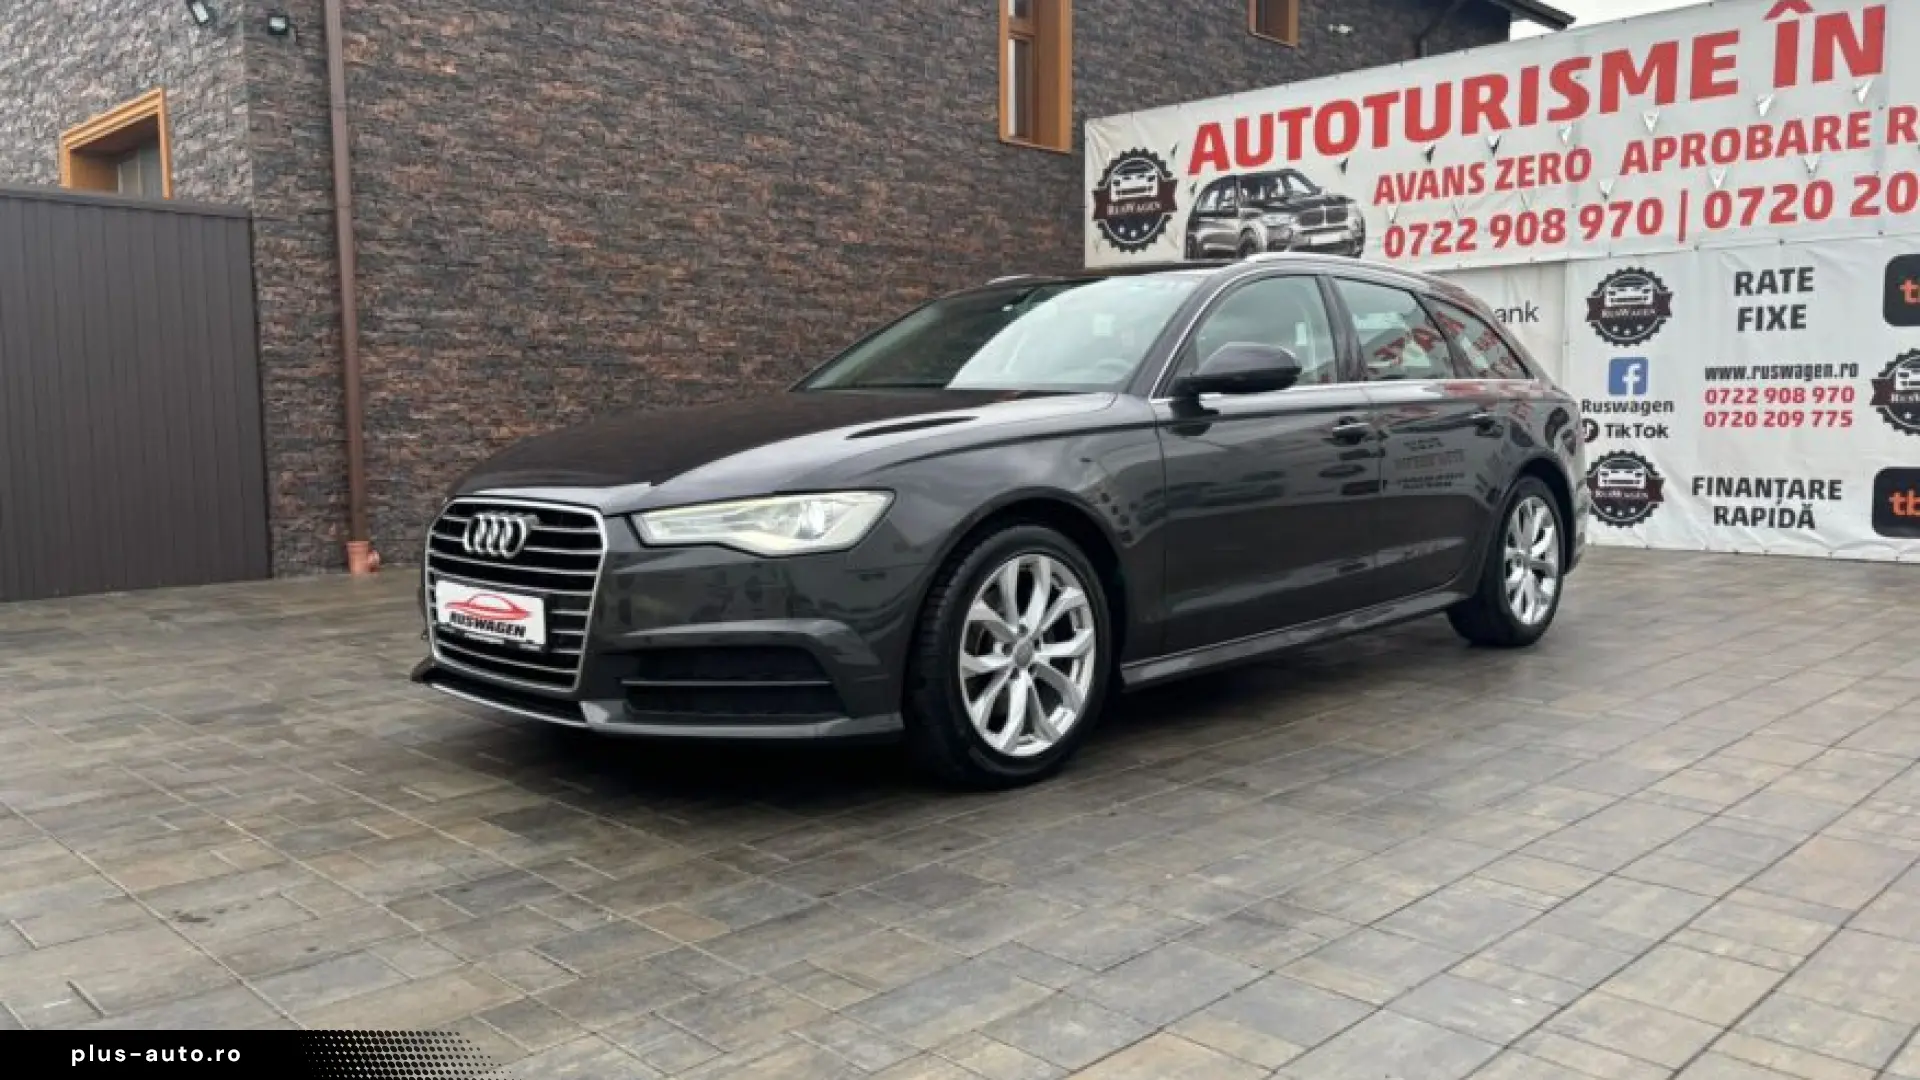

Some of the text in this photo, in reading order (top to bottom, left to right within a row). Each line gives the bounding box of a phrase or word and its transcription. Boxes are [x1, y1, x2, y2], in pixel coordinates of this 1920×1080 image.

[1187, 0, 1887, 176] AUTOTURISME ÎN
[1373, 162, 1487, 207] AVANS
[1493, 147, 1594, 192] ZERO
[1618, 110, 1873, 176] APROBARE
[1383, 217, 1479, 259] 0722
[1489, 207, 1567, 249] 908
[1578, 198, 1665, 241] 970
[1702, 178, 1835, 229] 0720
[1849, 170, 1920, 219] 20
[1734, 266, 1815, 297] RATE
[1494, 300, 1541, 323] ank
[1737, 304, 1807, 332] FIXE
[1704, 363, 1860, 382] www.ruswagen.ro
[1581, 399, 1675, 416] Ruswagen
[1704, 386, 1855, 405] 0722 908 970
[1604, 423, 1669, 439] TikTok
[1704, 410, 1853, 428] 0720 209 775
[1713, 503, 1816, 530] RAPIDĂ
